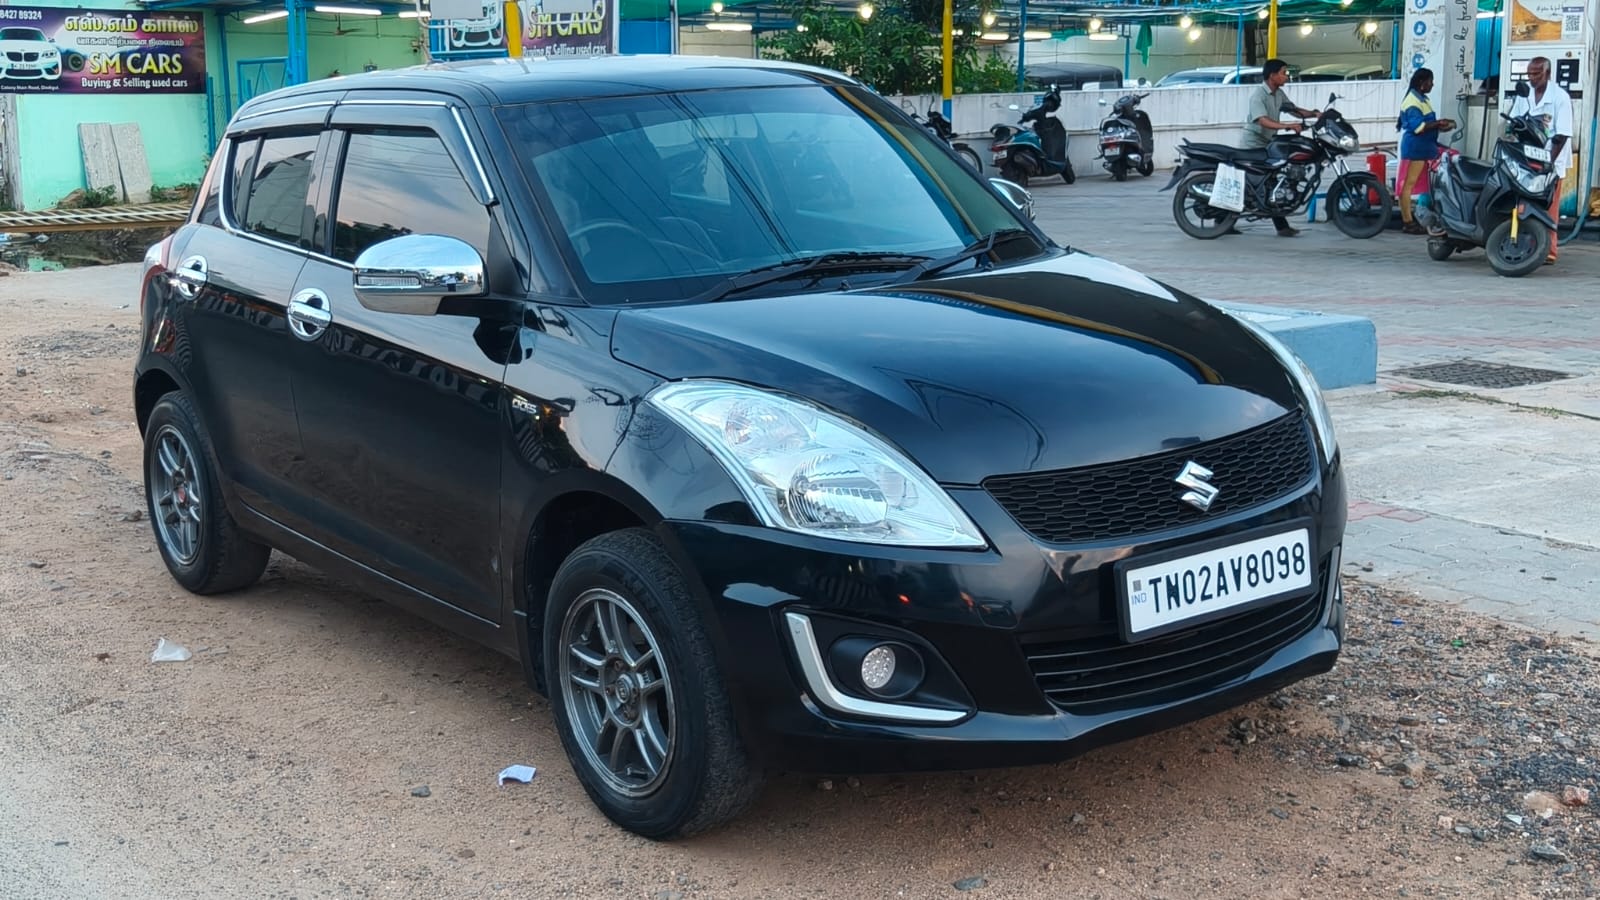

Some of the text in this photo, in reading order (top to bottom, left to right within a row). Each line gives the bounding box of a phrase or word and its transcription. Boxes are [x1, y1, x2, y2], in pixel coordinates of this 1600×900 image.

[141, 15, 199, 33] கார்ஸ்
[528, 6, 603, 39] SM CARS
[89, 52, 184, 75] SM CARS
[81, 77, 188, 89] Buying & Selling used cars
[1149, 542, 1306, 613] TN02AV8098
[1131, 592, 1147, 605] IND
